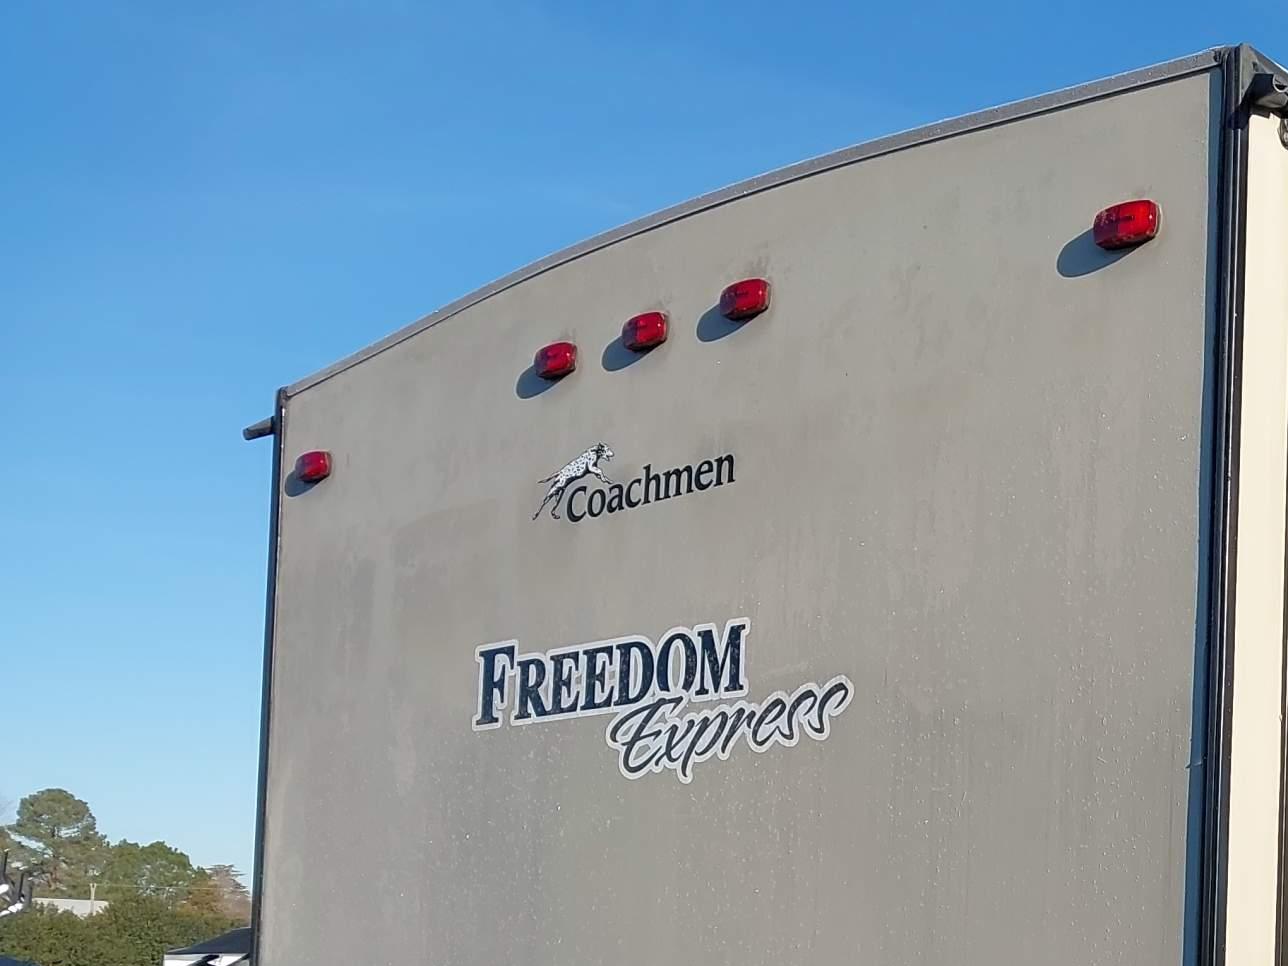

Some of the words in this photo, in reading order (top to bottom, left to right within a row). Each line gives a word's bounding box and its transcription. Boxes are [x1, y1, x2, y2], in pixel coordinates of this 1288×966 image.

[566, 453, 736, 523] Coachmen
[474, 619, 749, 730] FREEDOM
[607, 677, 853, 782] Express
